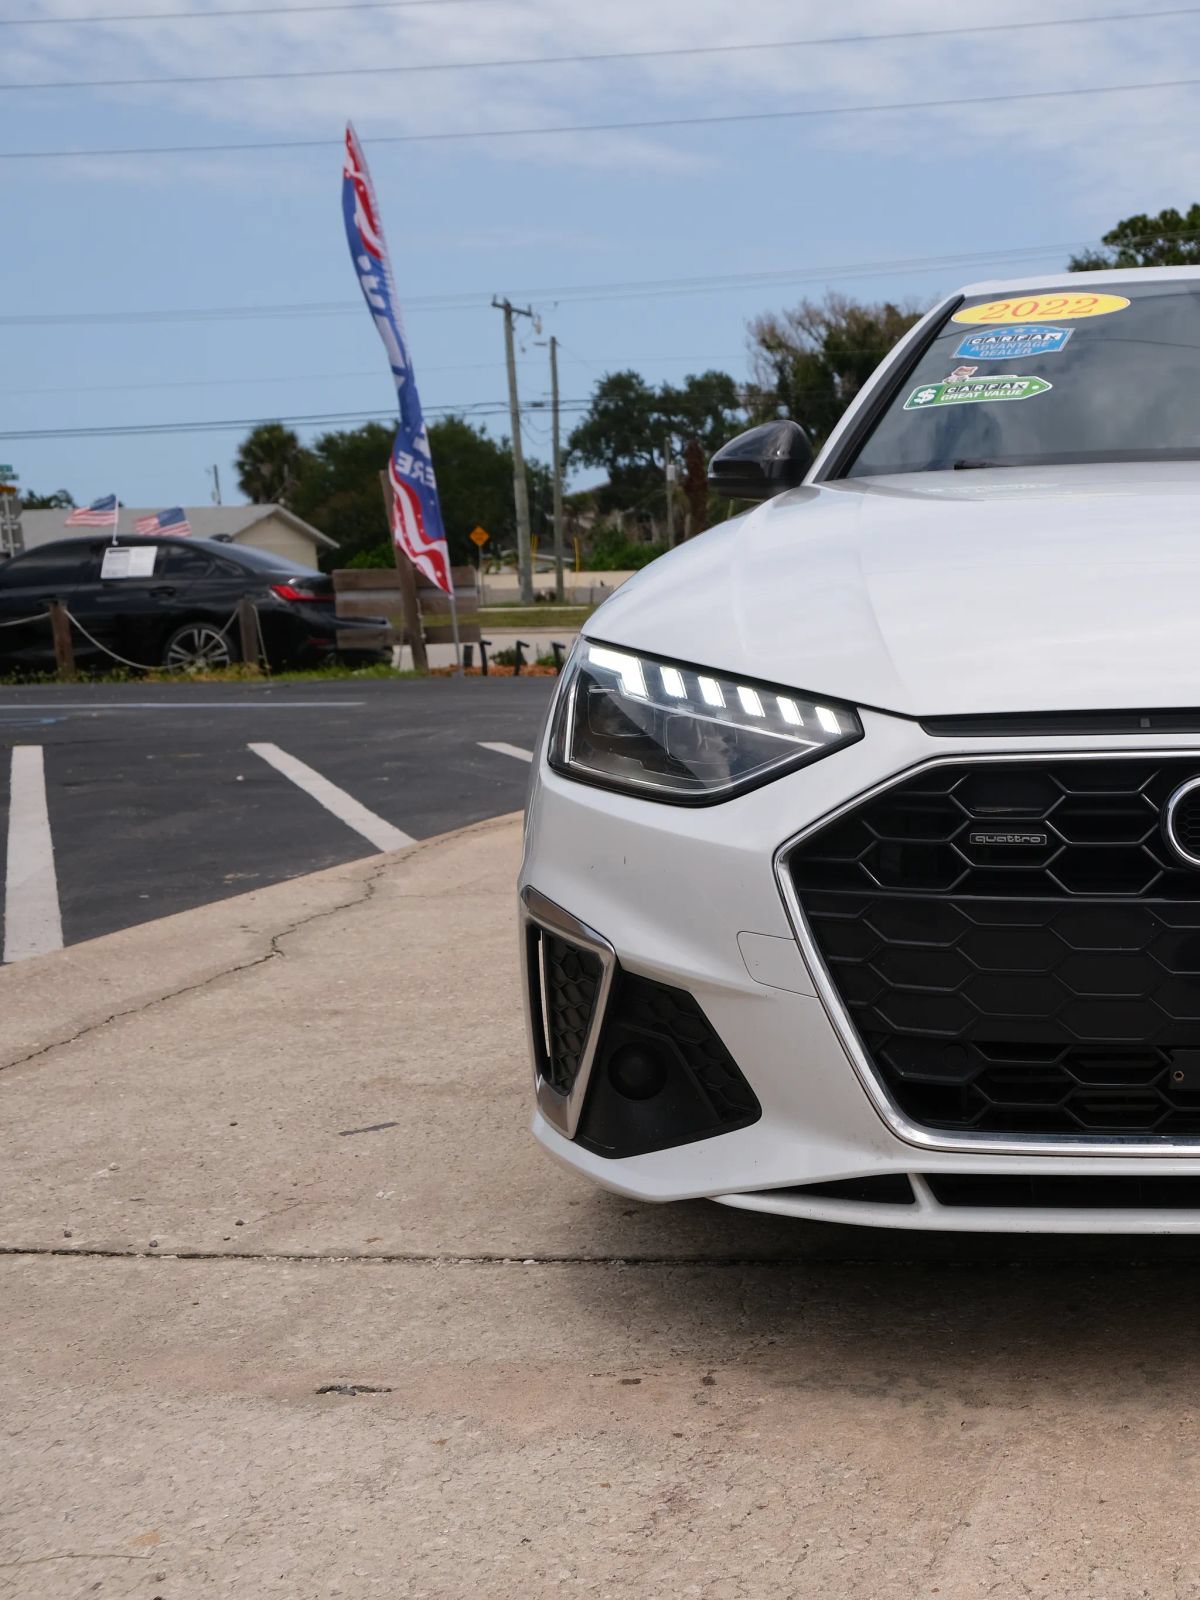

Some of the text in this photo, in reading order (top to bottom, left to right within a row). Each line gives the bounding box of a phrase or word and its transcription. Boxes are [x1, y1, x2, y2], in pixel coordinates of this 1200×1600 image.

[979, 297, 1099, 321] 2022
[969, 332, 1063, 345] CARFAX
[970, 340, 1050, 352] ADVANTAGE
[979, 347, 1033, 357] DEALER
[944, 381, 1029, 394] CARFAX
[941, 388, 1024, 401] GREAT VALUE
[975, 835, 1041, 844] quattro
